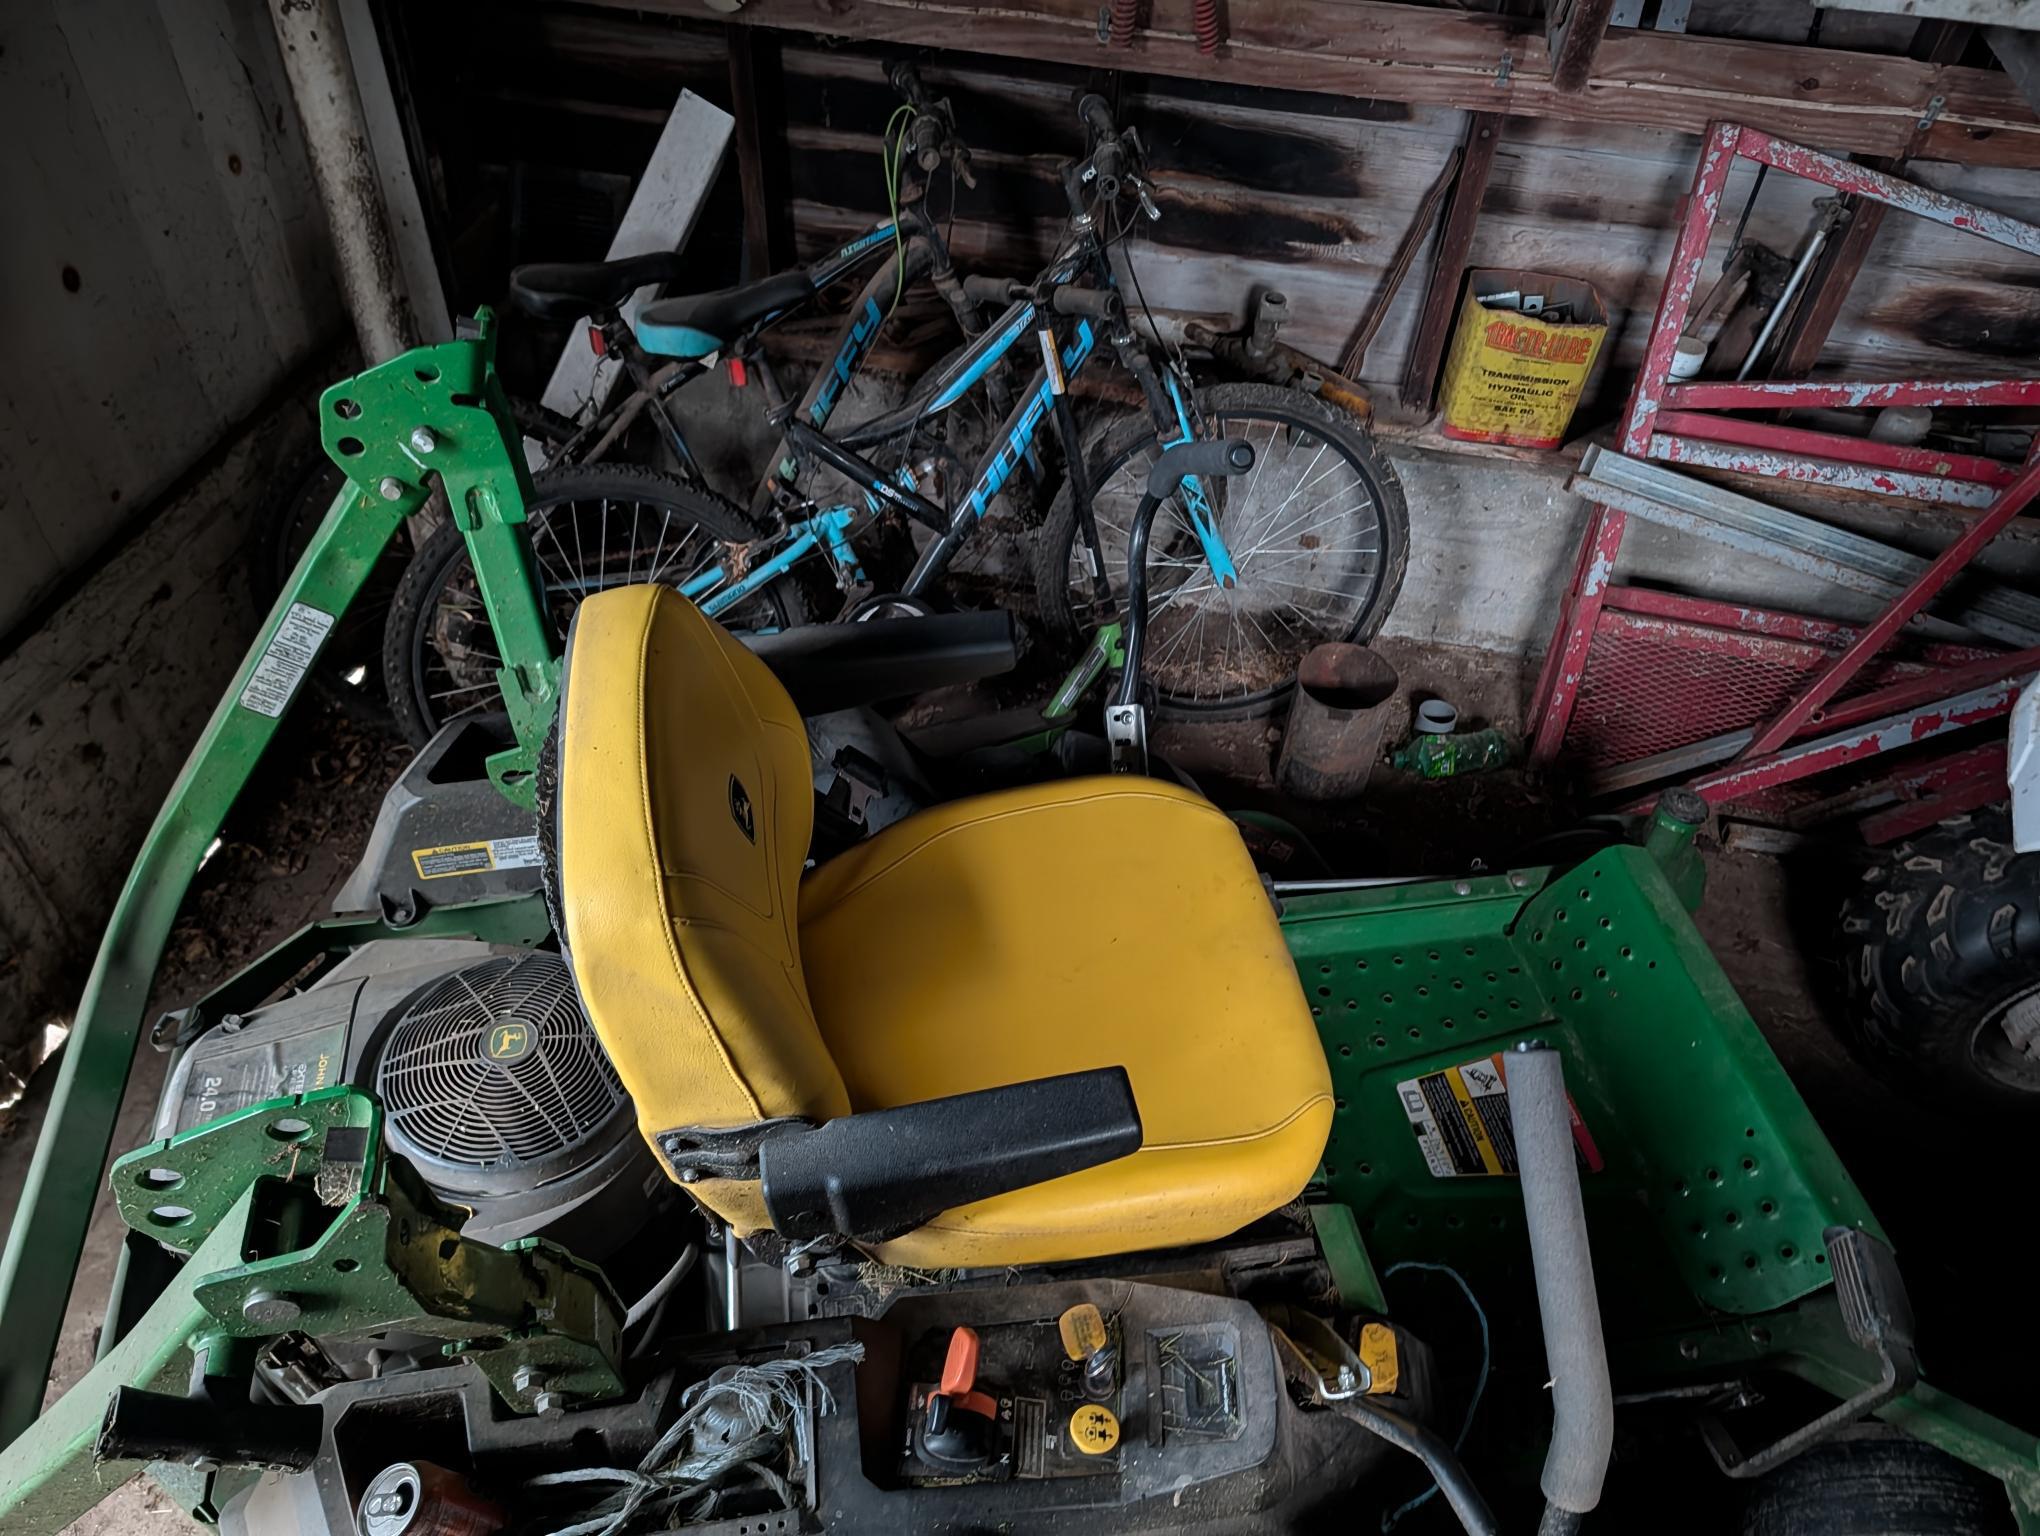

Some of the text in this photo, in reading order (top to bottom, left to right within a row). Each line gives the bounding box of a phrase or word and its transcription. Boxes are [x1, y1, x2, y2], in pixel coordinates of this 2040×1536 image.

[1481, 368, 1570, 386] TRANSMISSION
[1488, 382, 1554, 398] HYDRAULIC
[1510, 394, 1528, 402] OIL
[971, 318, 1094, 520] HUFY
[315, 1052, 329, 1086] JOHN
[200, 1076, 223, 1112] 24.0
[1464, 1102, 1484, 1143] CAUTION
